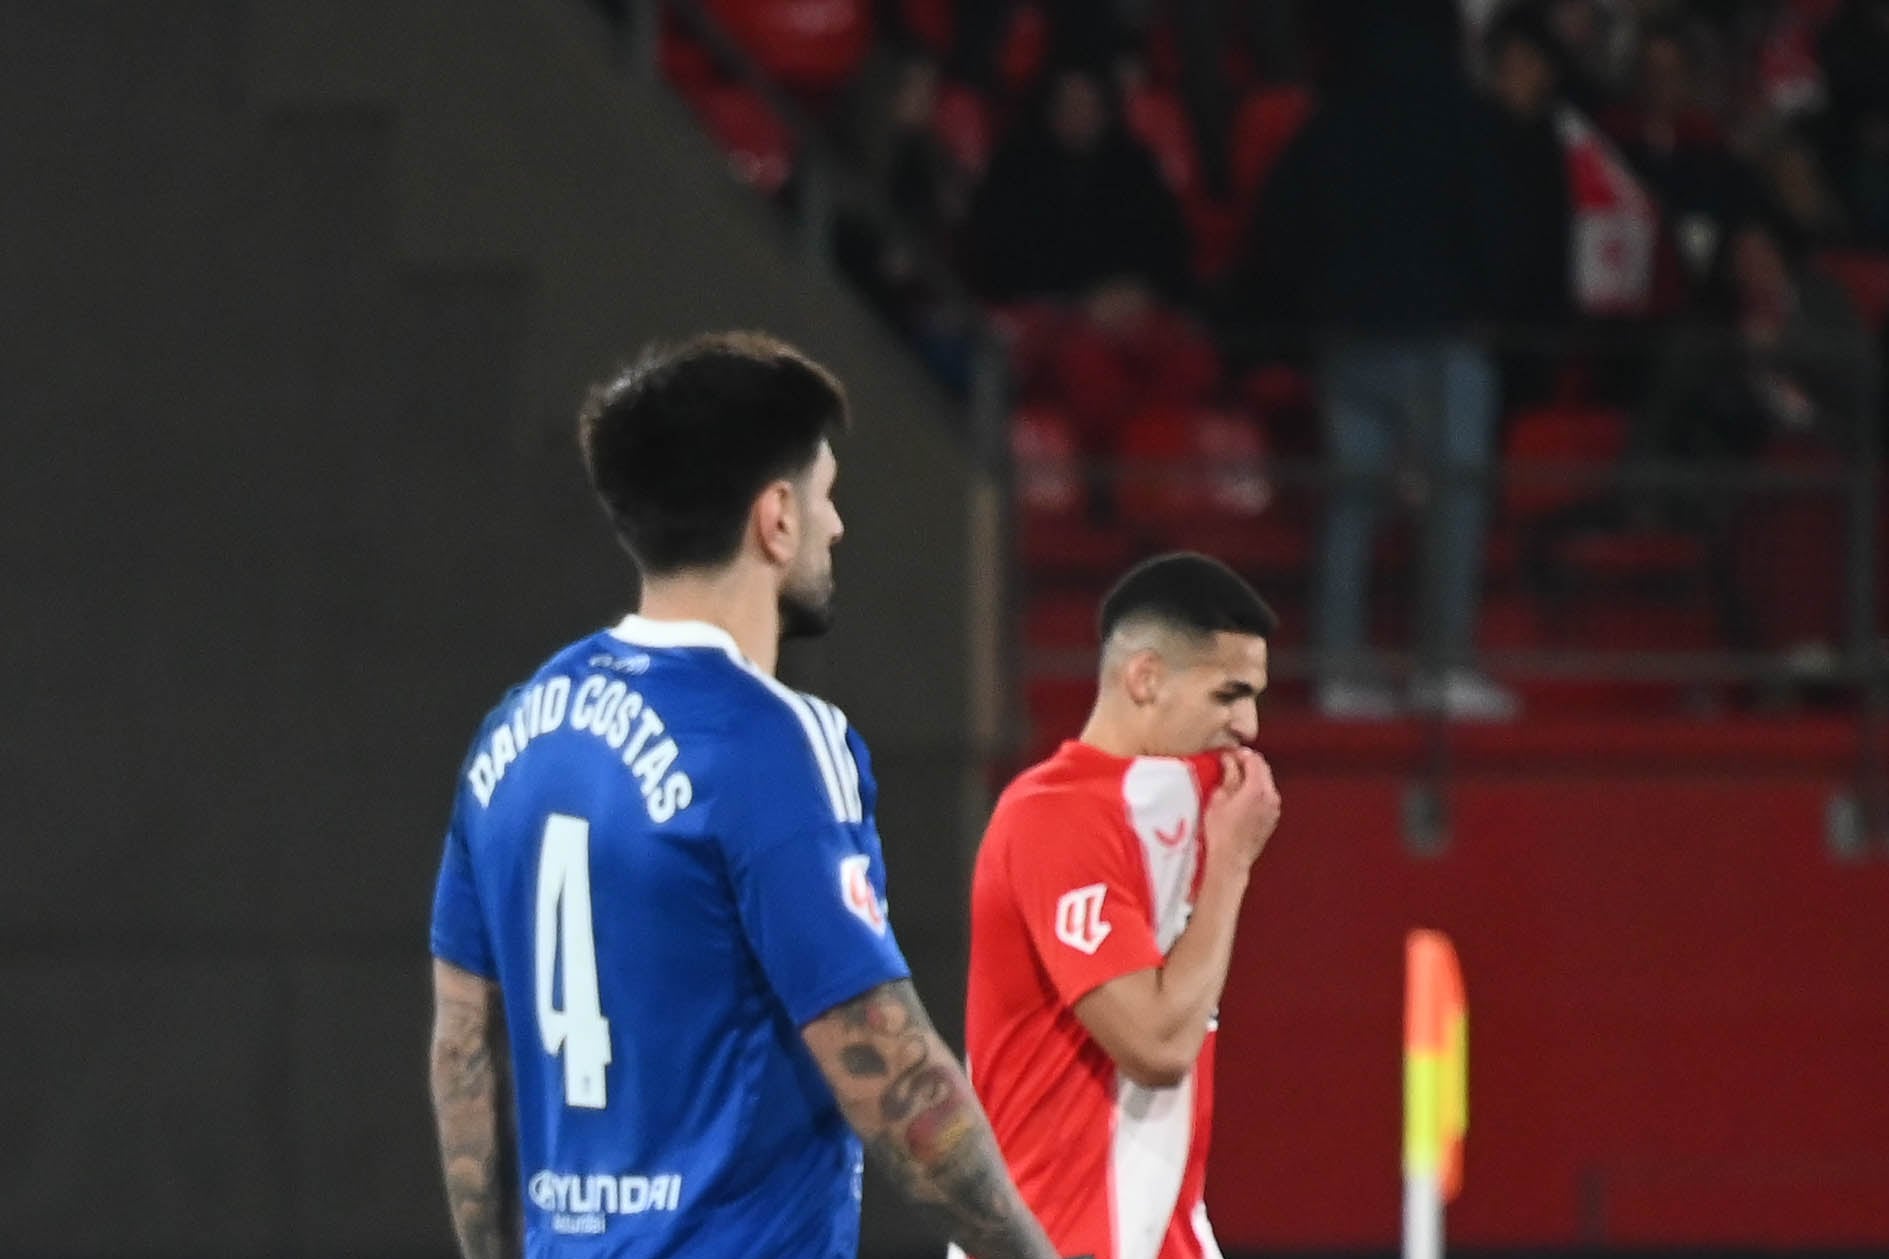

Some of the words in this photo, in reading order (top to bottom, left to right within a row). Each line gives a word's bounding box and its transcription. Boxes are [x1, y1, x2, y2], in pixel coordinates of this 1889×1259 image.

[469, 675, 571, 808] DAVID
[570, 673, 693, 824] COSTAS
[535, 814, 611, 1110] 4
